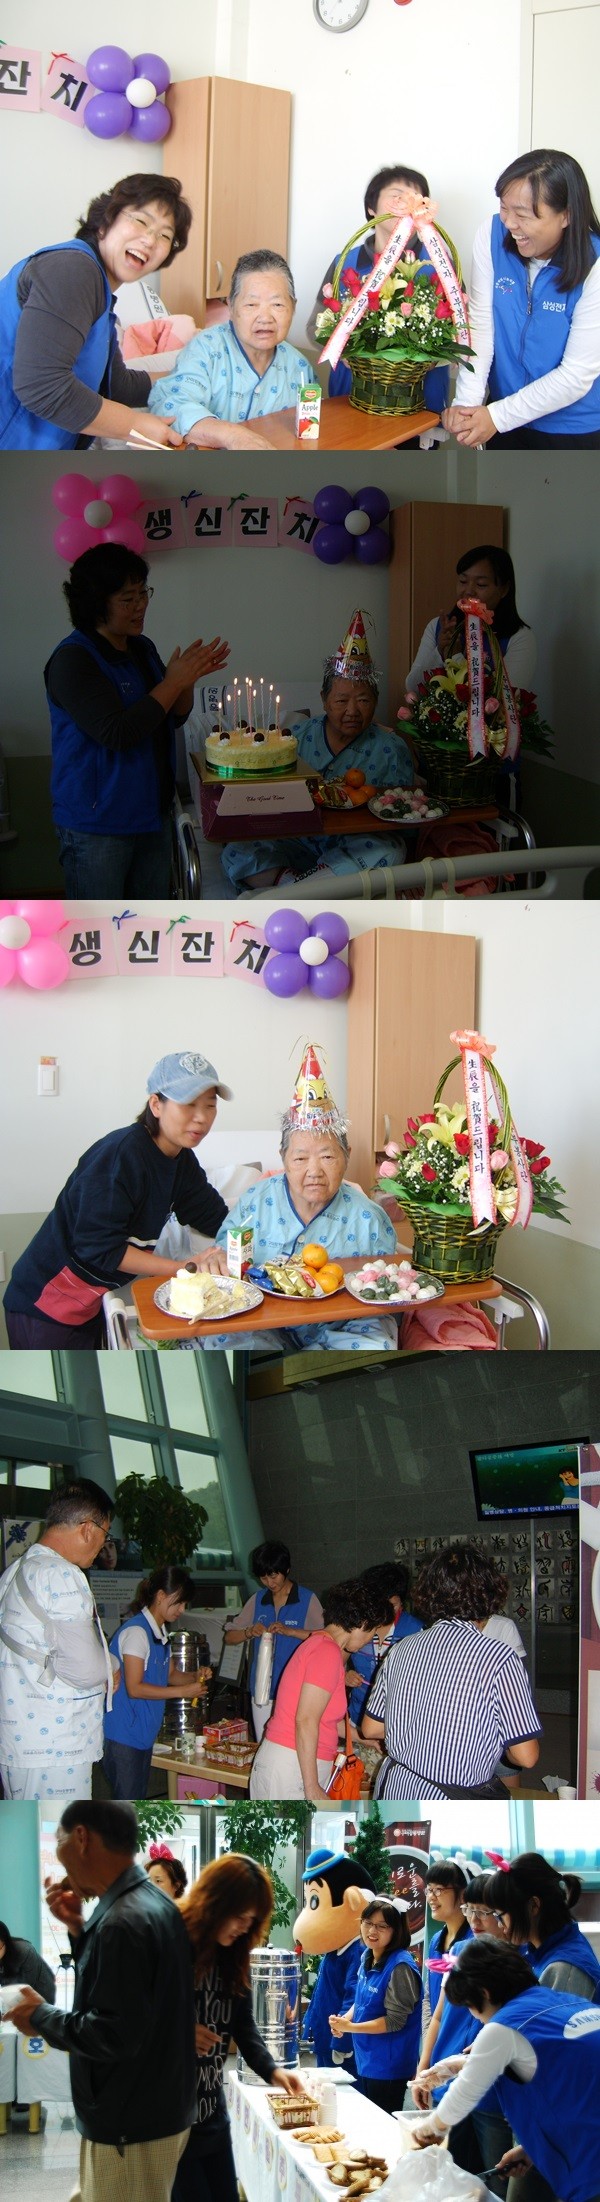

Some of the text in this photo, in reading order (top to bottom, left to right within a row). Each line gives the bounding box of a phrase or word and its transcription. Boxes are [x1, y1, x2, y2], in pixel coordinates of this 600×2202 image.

[429, 237, 453, 278] 삼성전자
[568, 2014, 600, 2028] SAMS
[28, 2037, 44, 2053] 호
